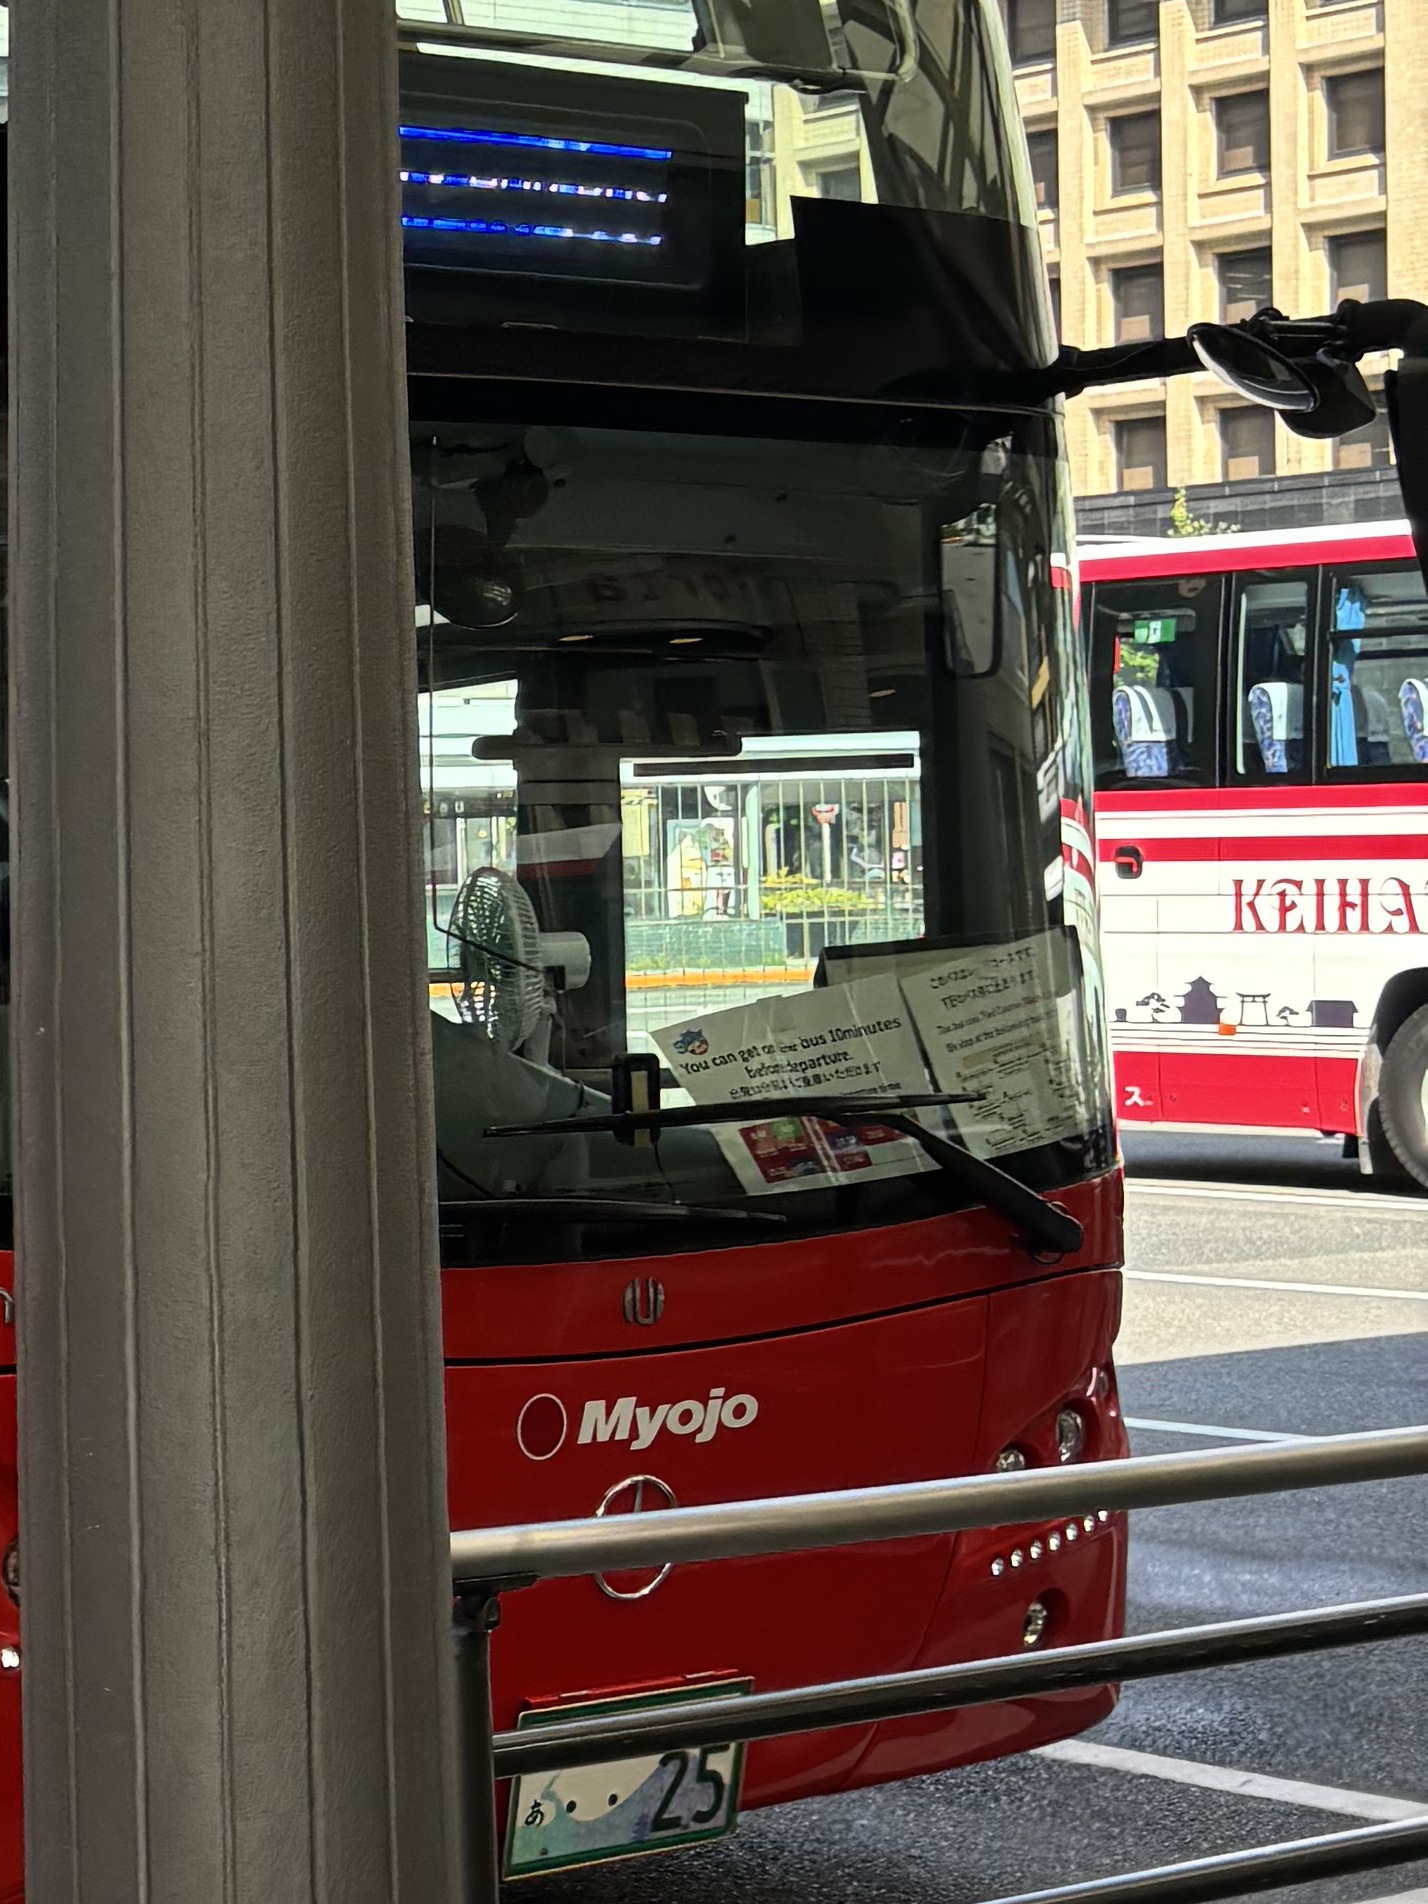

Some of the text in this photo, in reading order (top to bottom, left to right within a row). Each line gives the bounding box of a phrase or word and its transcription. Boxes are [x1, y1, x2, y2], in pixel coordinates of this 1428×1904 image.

[1232, 877, 1428, 934] KEIHA
[680, 1059, 711, 1076] You
[712, 1051, 738, 1067] can
[801, 1034, 828, 1050] bus
[577, 1387, 758, 1450] Myojo
[524, 1799, 545, 1827] あ
